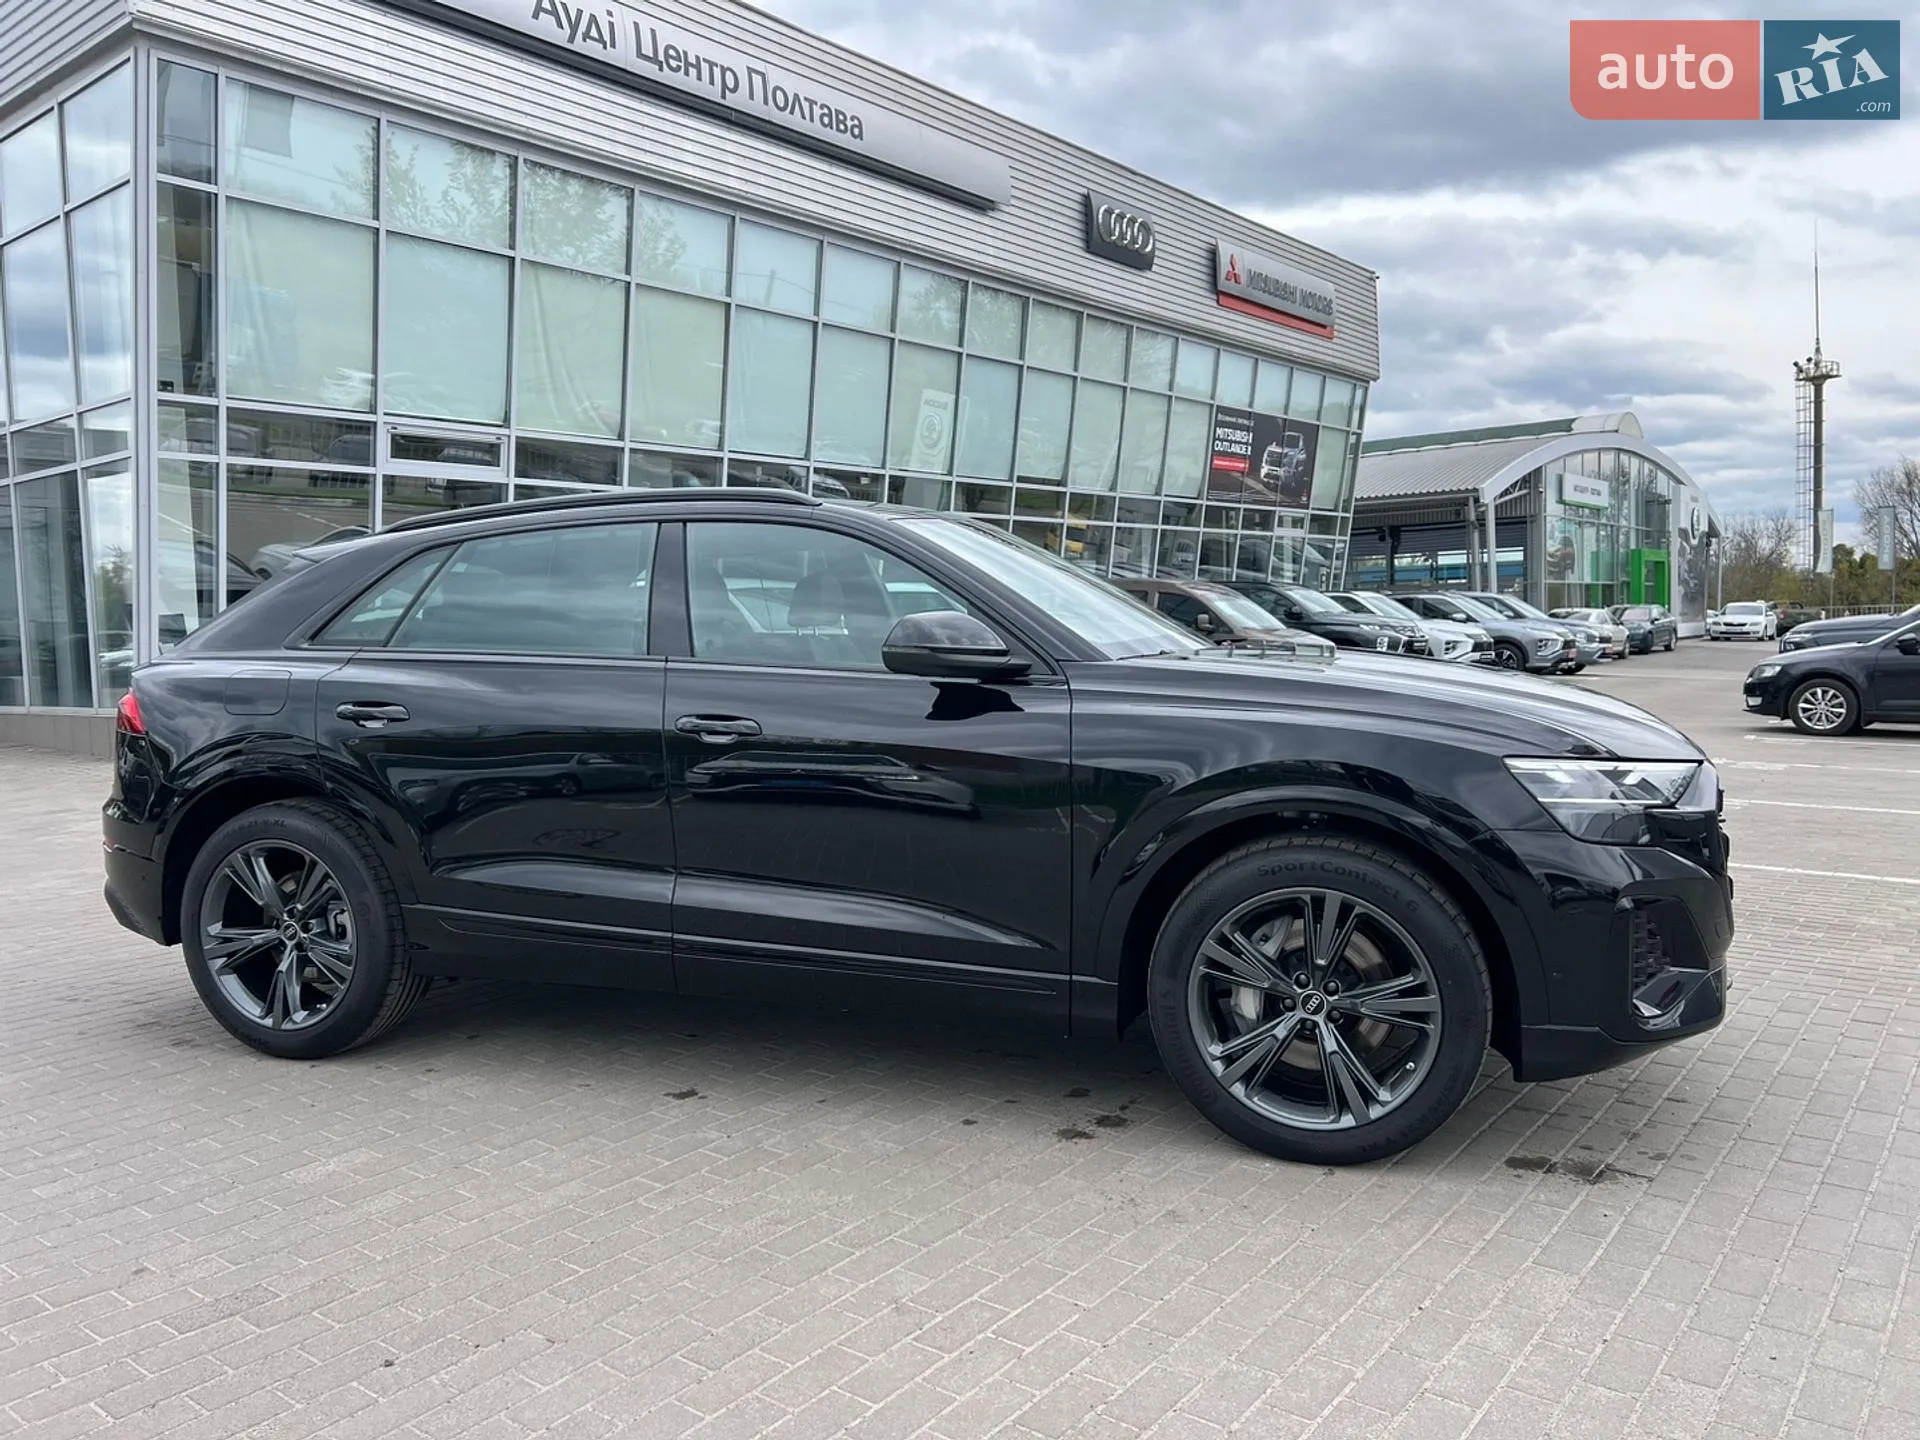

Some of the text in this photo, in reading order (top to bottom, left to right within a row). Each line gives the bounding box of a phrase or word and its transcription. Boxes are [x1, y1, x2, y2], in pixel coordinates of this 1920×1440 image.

[531, 0, 864, 141] Ауді Центр Полтава
[1246, 268, 1334, 316] MITSUBISHI MOTORS
